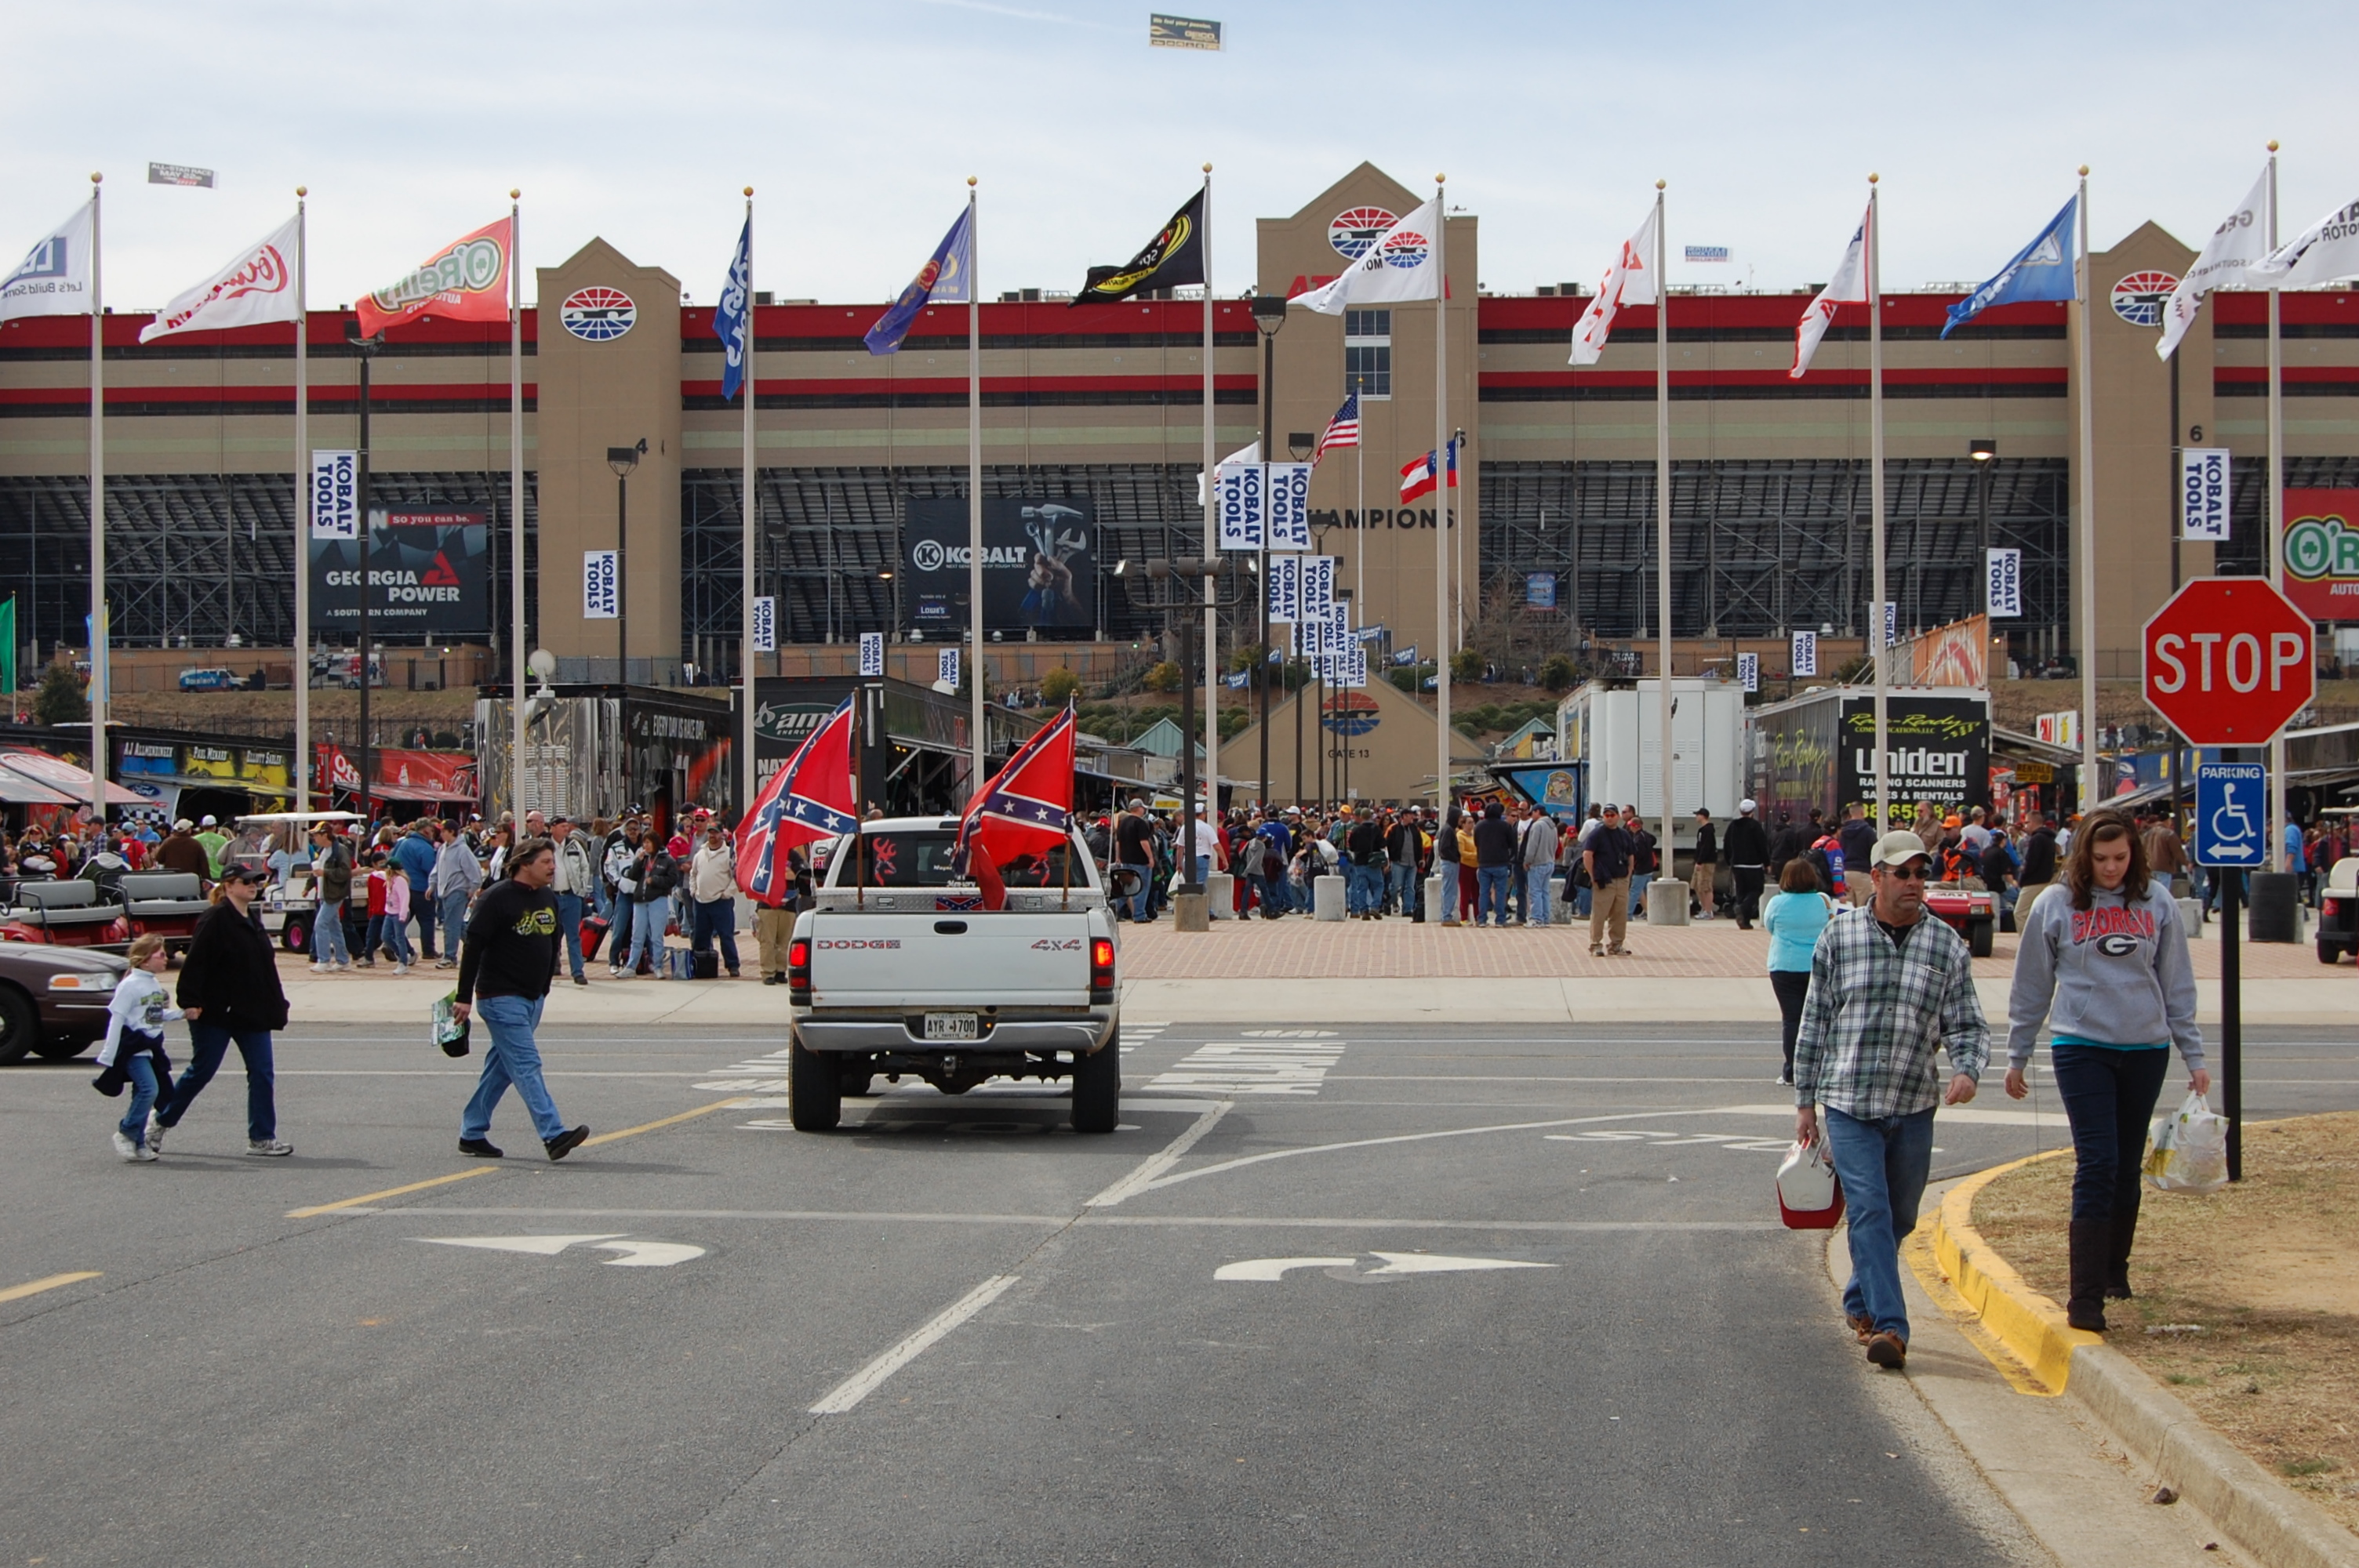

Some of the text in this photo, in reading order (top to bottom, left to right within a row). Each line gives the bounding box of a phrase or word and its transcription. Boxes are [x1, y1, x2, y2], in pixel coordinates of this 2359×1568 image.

[1184, 30, 1215, 39] GEICO
[159, 169, 181, 178] MAY
[191, 167, 212, 177] RACE
[635, 437, 649, 454] 4
[2190, 426, 2203, 442] 6
[317, 463, 333, 527] TOOLS
[336, 456, 352, 535] KOBALT
[1225, 476, 1241, 538] TOOLS
[1244, 468, 1260, 545] KOBALT
[1273, 475, 1289, 539] TOOLS
[1291, 467, 1307, 545] KOBALT
[2186, 463, 2202, 528] TOOLS
[2206, 455, 2222, 535] KOBALT
[411, 515, 431, 525] you
[456, 514, 470, 523] be.
[946, 546, 1026, 564] KOBALT
[388, 587, 460, 602] POWER
[587, 561, 600, 608] TOOLS
[602, 554, 614, 615] KOBALT
[1269, 565, 1281, 614] TOOLS
[1283, 559, 1295, 619] KOBALT
[1305, 565, 1317, 613] TOOLS
[1319, 560, 1330, 619] KOBALT
[1990, 559, 2002, 607] TOOLS
[2005, 553, 2016, 612] KOBALT
[761, 601, 772, 648] KOBALT
[1336, 606, 1345, 653] KOBALT
[1805, 633, 1813, 673] KOBALT
[2154, 633, 2304, 694] STOP
[653, 714, 668, 736] EVERY
[669, 716, 678, 737] DAY
[684, 718, 695, 739] RACE
[775, 713, 830, 730] am
[1848, 713, 1961, 732] Ra-Ready
[1358, 750, 1369, 758] 13
[2201, 768, 2260, 779] PARKING
[1859, 778, 1967, 788] RANG SCANNERS
[1862, 790, 1965, 800] SAES & RENTALS
[817, 939, 900, 949] DODGE
[2073, 906, 2154, 945] GEORGIA
[927, 1020, 945, 1033] AYR
